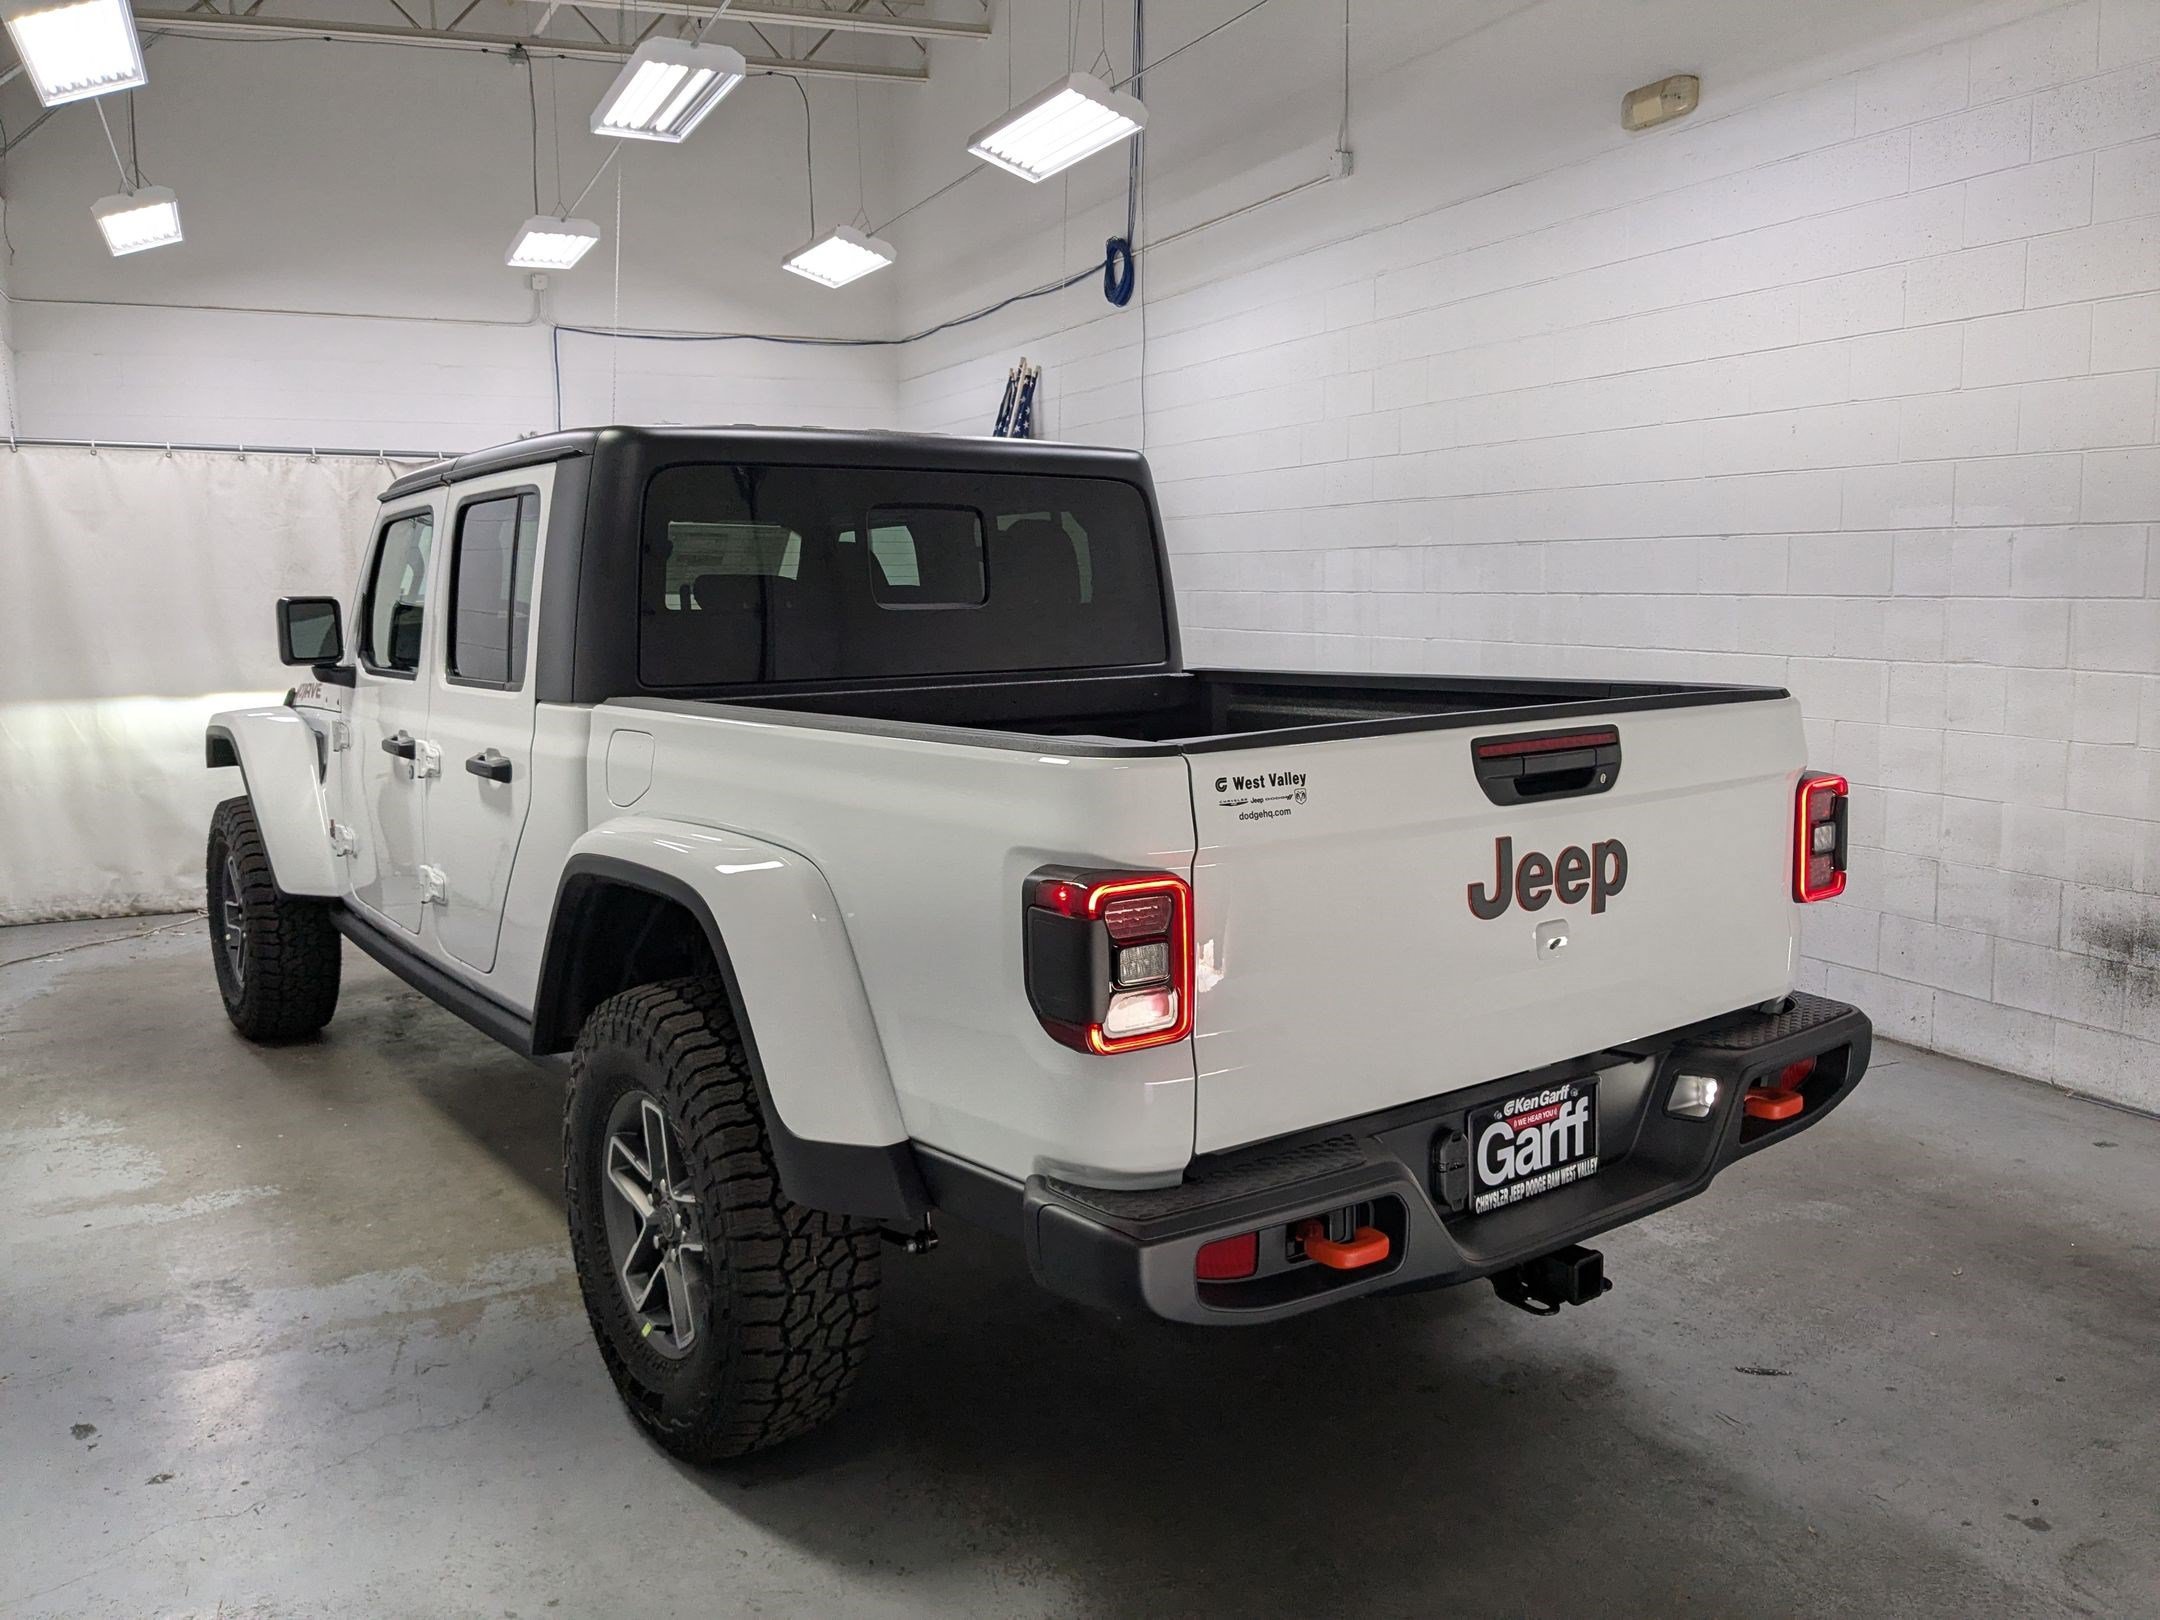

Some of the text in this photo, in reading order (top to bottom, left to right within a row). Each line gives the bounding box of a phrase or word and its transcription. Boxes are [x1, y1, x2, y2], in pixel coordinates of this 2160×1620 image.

[1232, 775, 1265, 791] West
[1268, 771, 1306, 787] Valley
[1238, 808, 1292, 821] dodgehq.com
[1467, 836, 1628, 920] Jeep
[1514, 1096, 1539, 1114] Ken
[1539, 1084, 1570, 1107] Garff
[1517, 1109, 1554, 1127] WE HEAR YOU
[1477, 1096, 1589, 1186] Garff
[1475, 1156, 1599, 1214] CHRYSLER JEEP DODGE RAM WEST VALLEY
